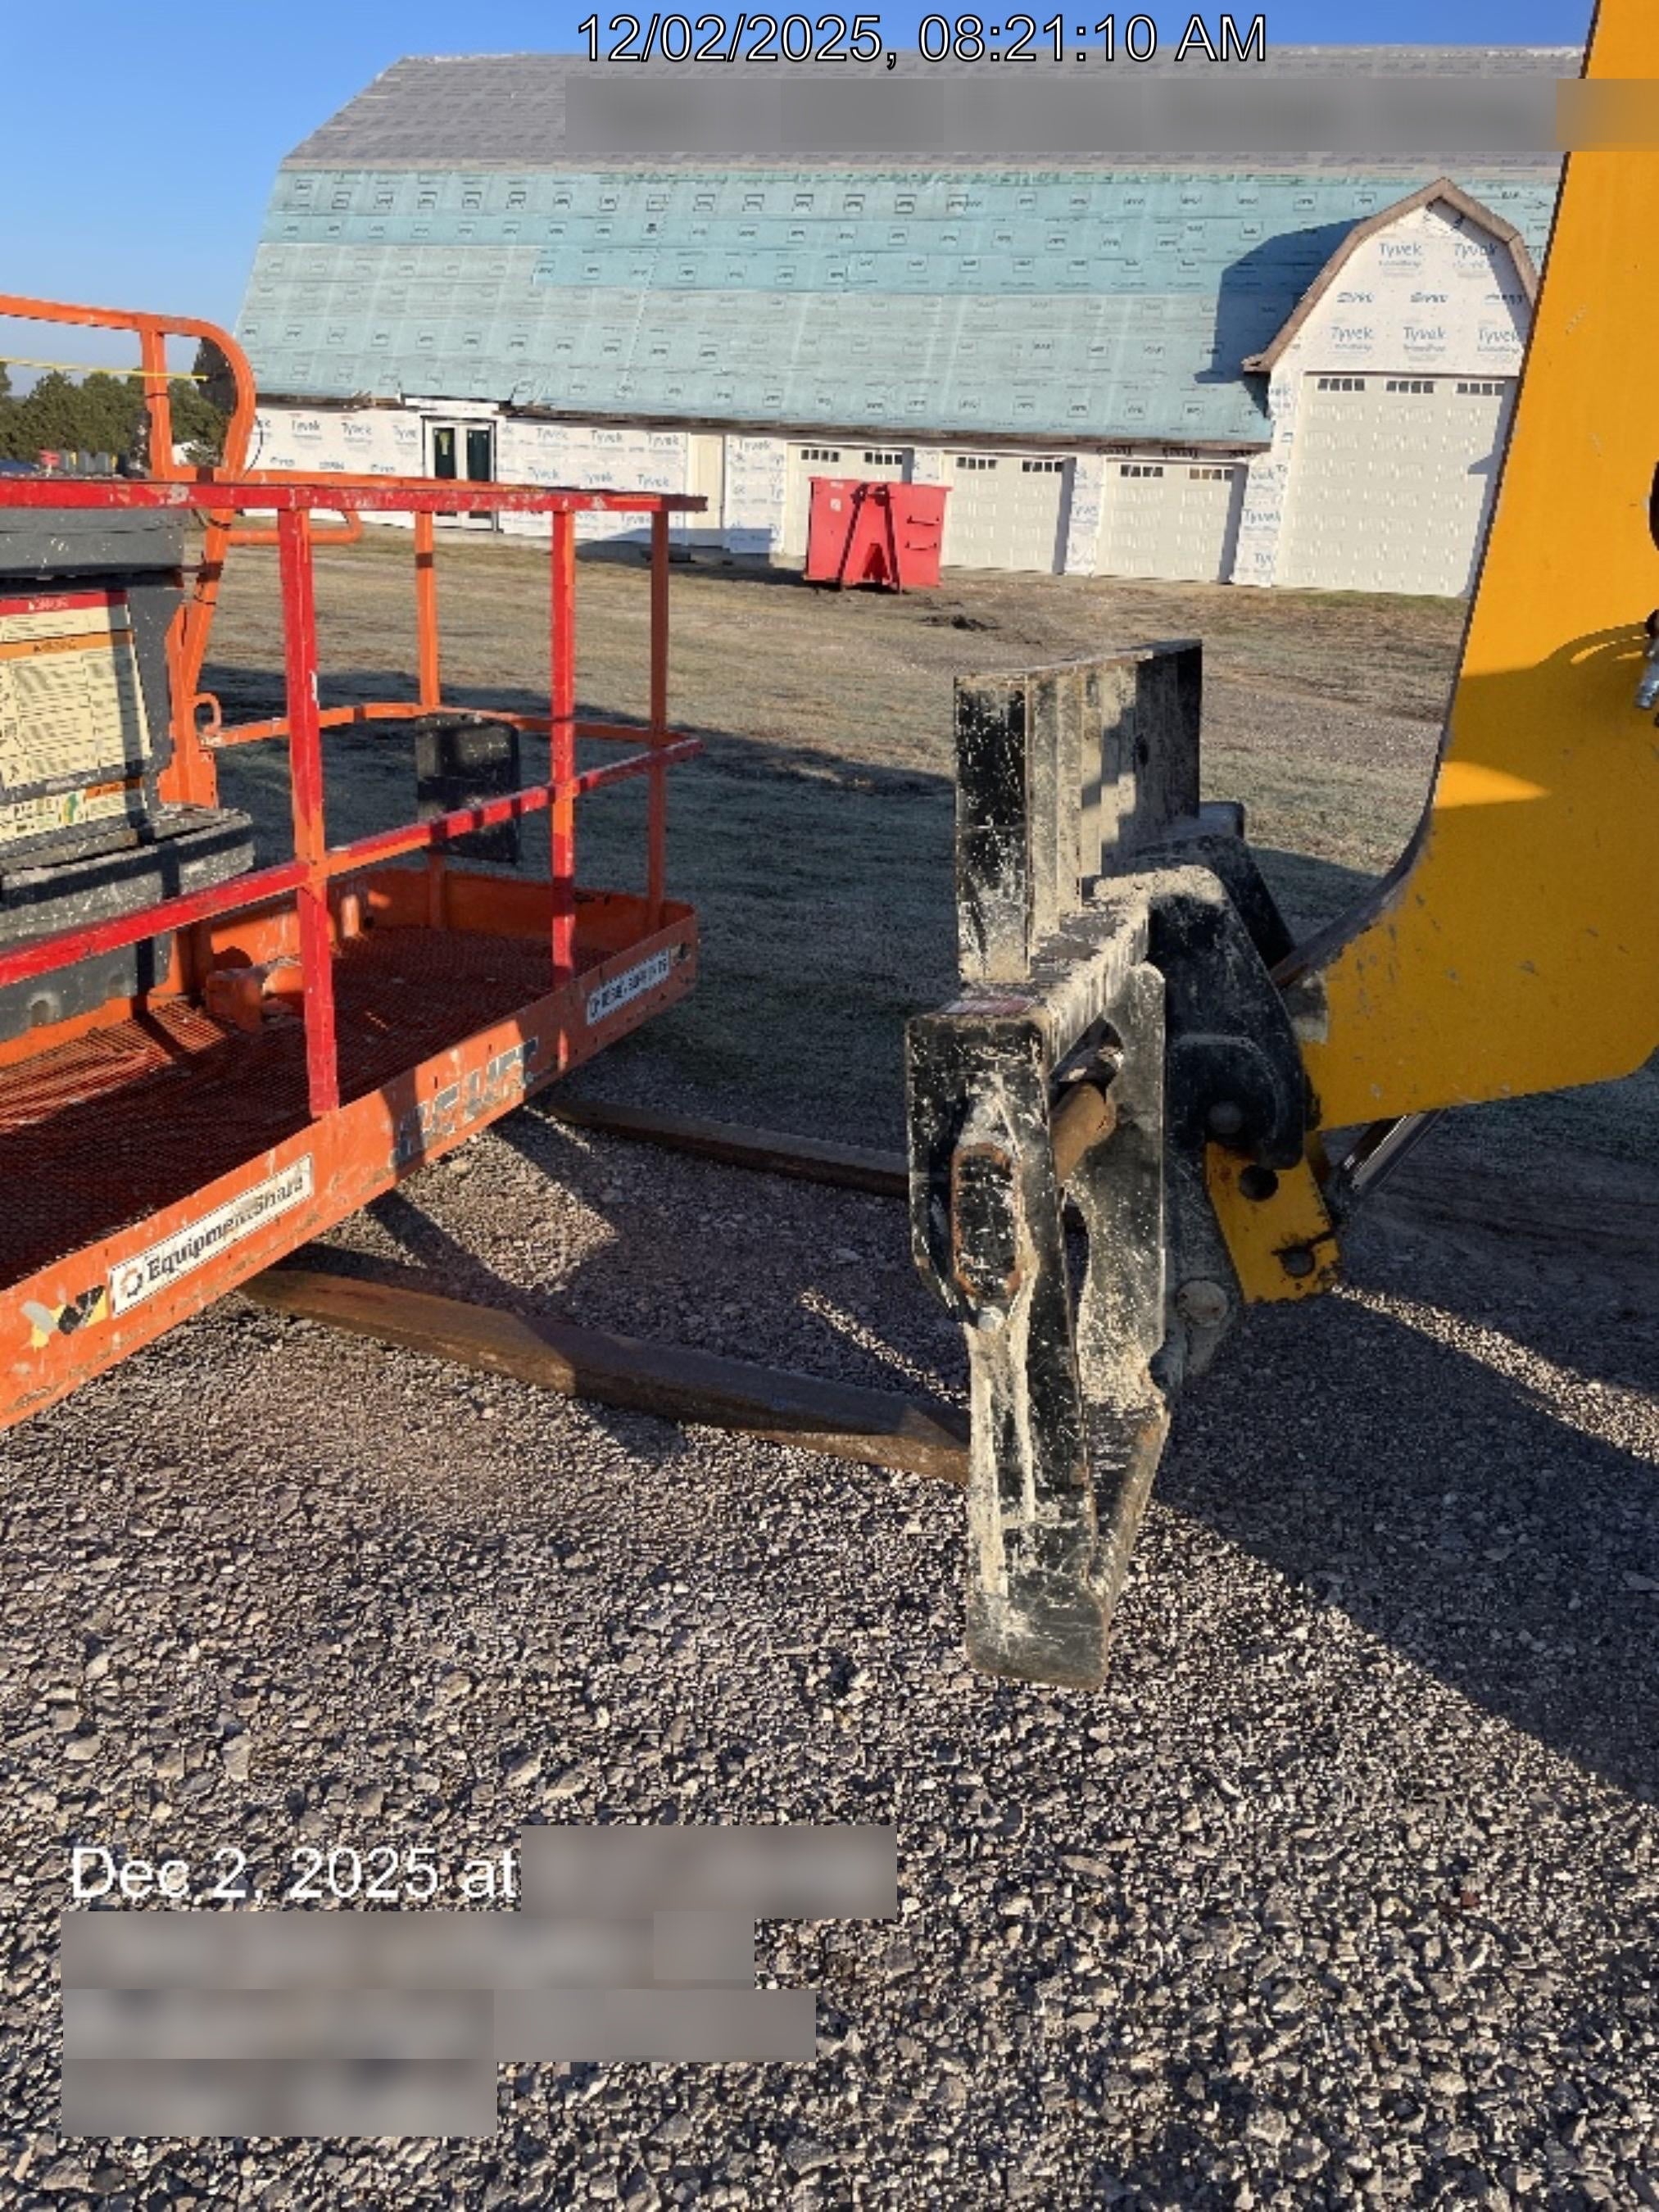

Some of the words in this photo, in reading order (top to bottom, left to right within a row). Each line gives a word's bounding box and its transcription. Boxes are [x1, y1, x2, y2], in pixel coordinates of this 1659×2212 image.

[1380, 243, 1422, 257] Tyvek
[1454, 243, 1498, 257] Tyvek
[1331, 327, 1374, 342] Tyvek
[1404, 327, 1446, 342] Tyvek
[1478, 328, 1521, 343] Tyvek
